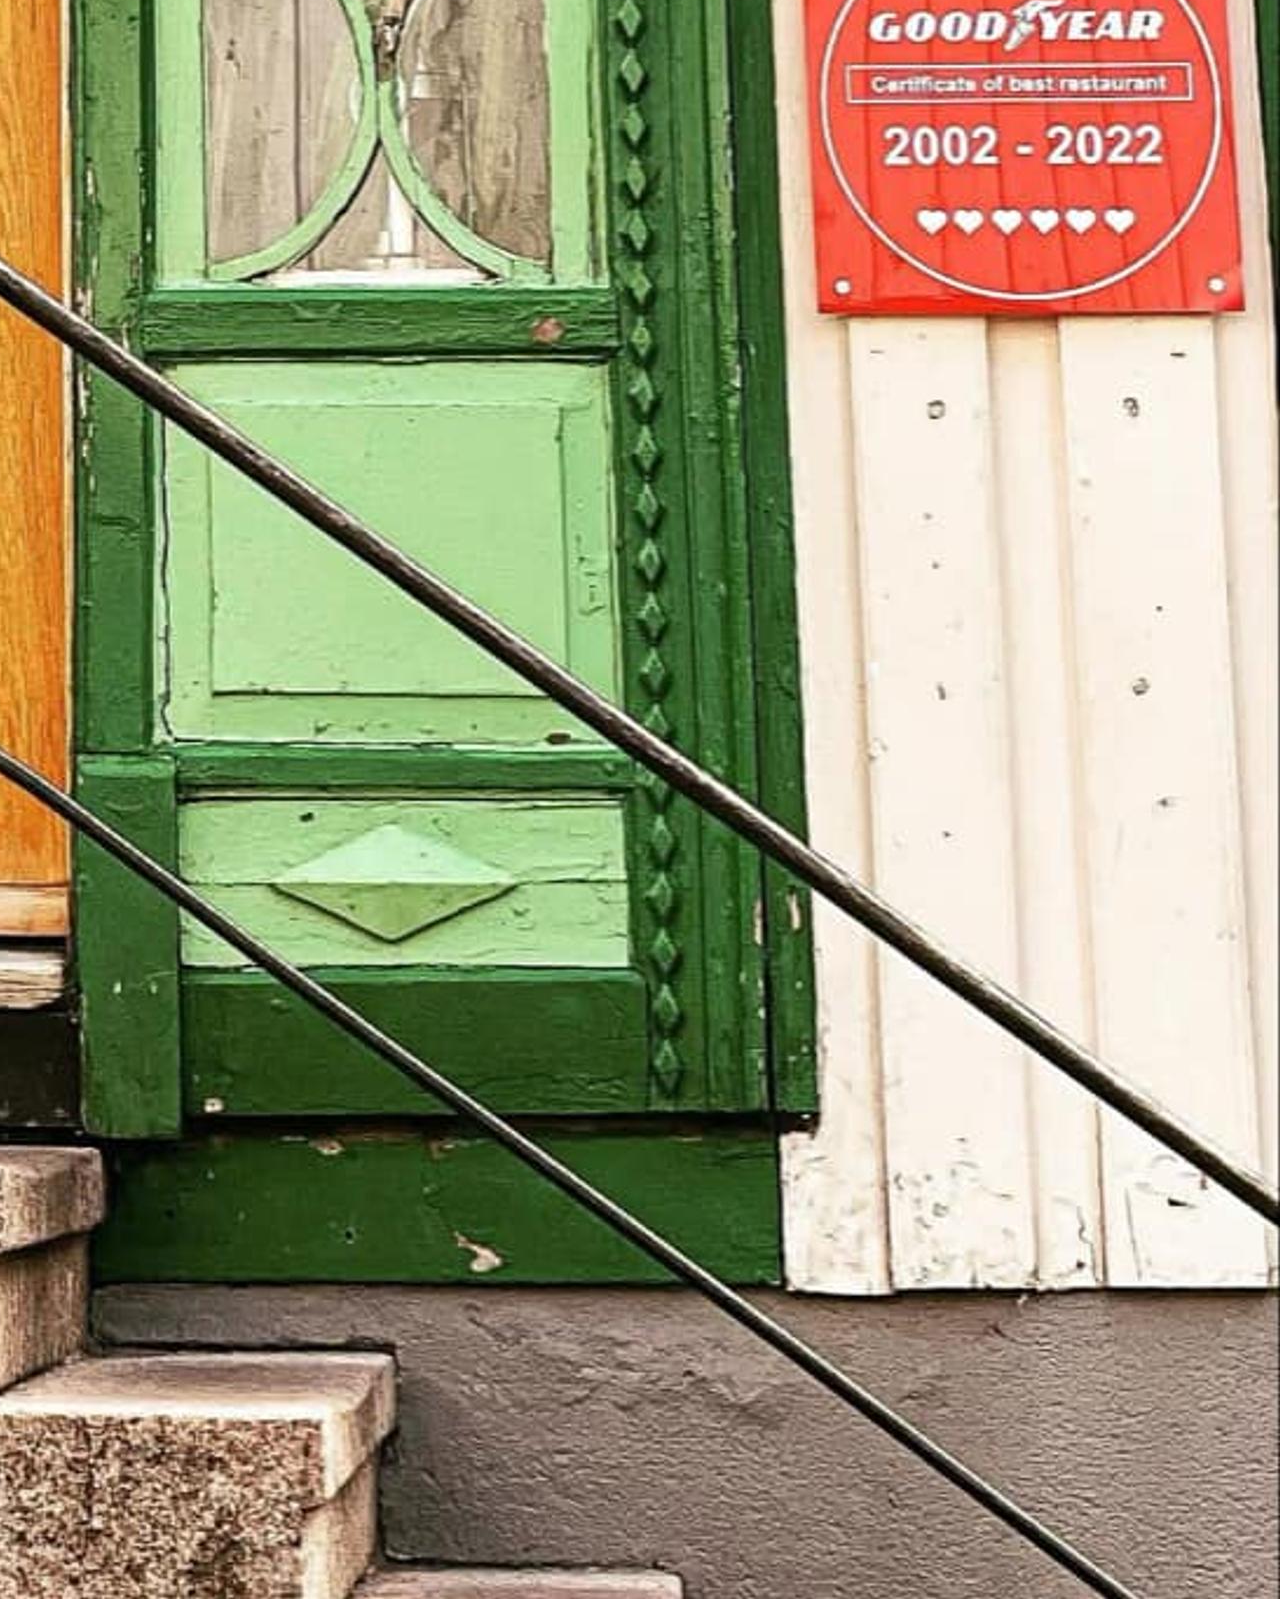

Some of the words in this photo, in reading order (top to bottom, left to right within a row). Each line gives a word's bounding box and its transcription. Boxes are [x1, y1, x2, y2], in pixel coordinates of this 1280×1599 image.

[982, 74, 1003, 93] of
[1009, 75, 1053, 93] best
[1059, 74, 1168, 92] restaurant
[883, 126, 999, 166] 2002
[1015, 144, 1034, 157] -
[1045, 124, 1164, 165] 2022
